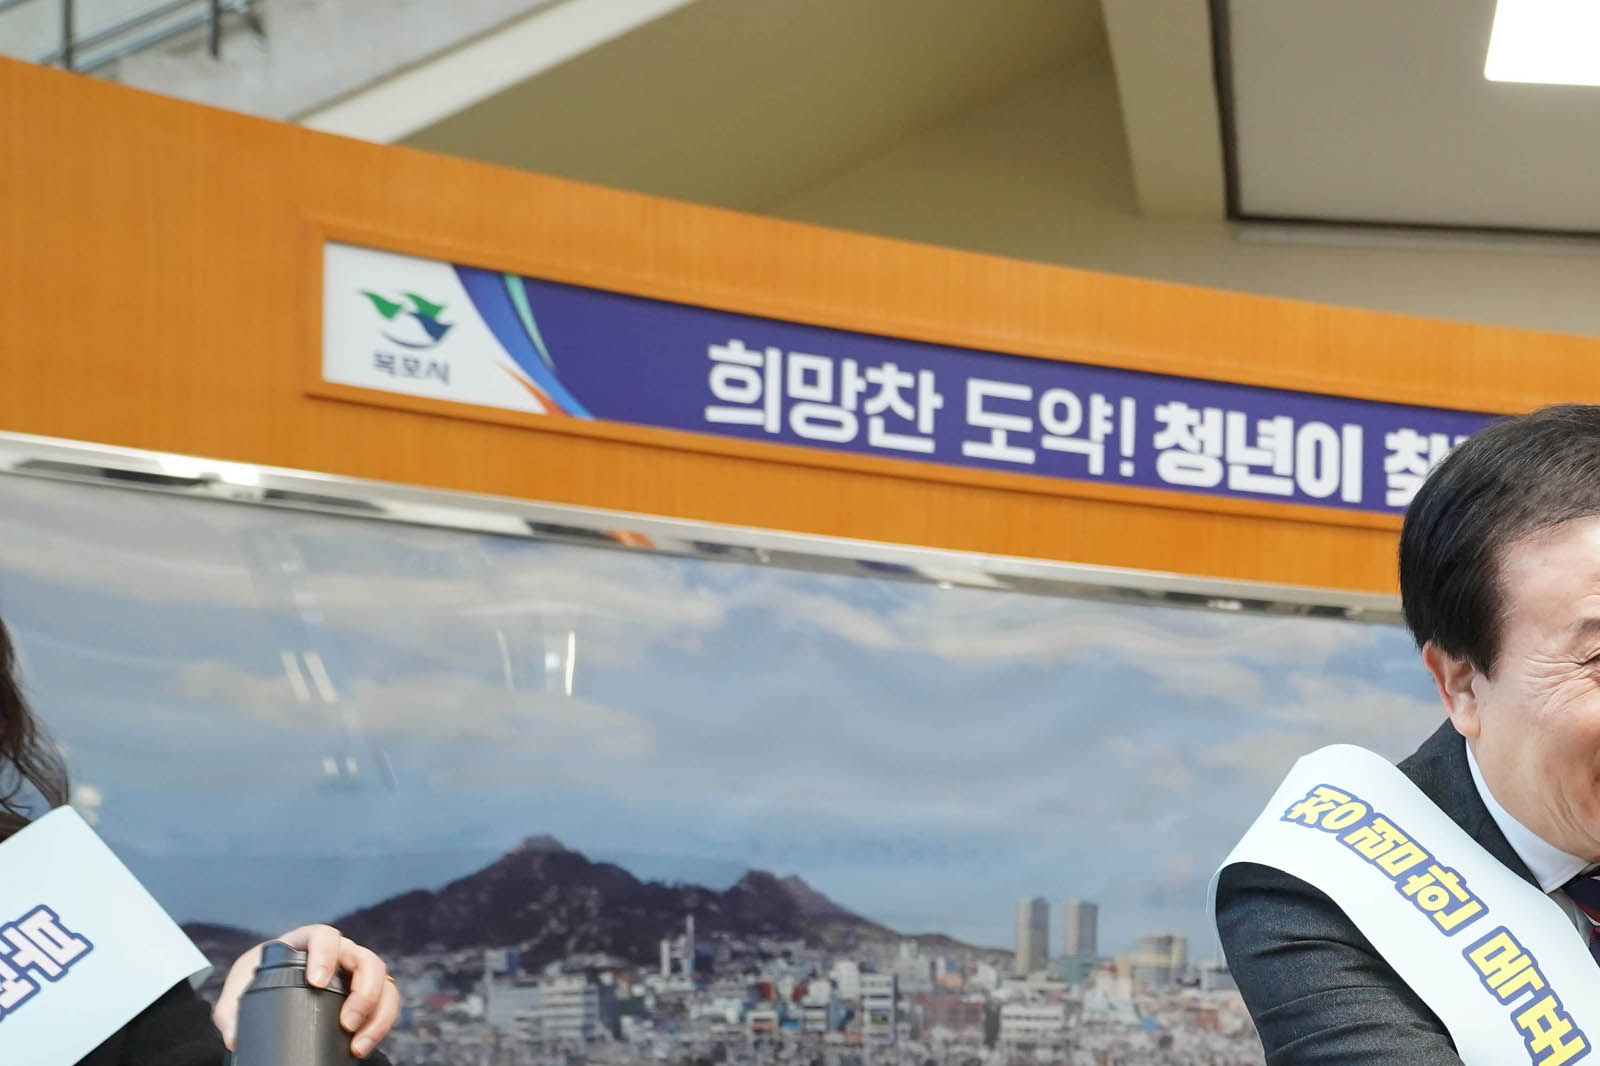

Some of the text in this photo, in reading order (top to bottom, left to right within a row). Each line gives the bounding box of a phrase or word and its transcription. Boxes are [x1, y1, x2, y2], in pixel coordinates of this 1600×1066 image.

[705, 339, 942, 454] 희망찬
[962, 377, 1135, 478] 도약!
[1153, 401, 1362, 504] 청년이
[1280, 783, 1488, 937] 청렴한
